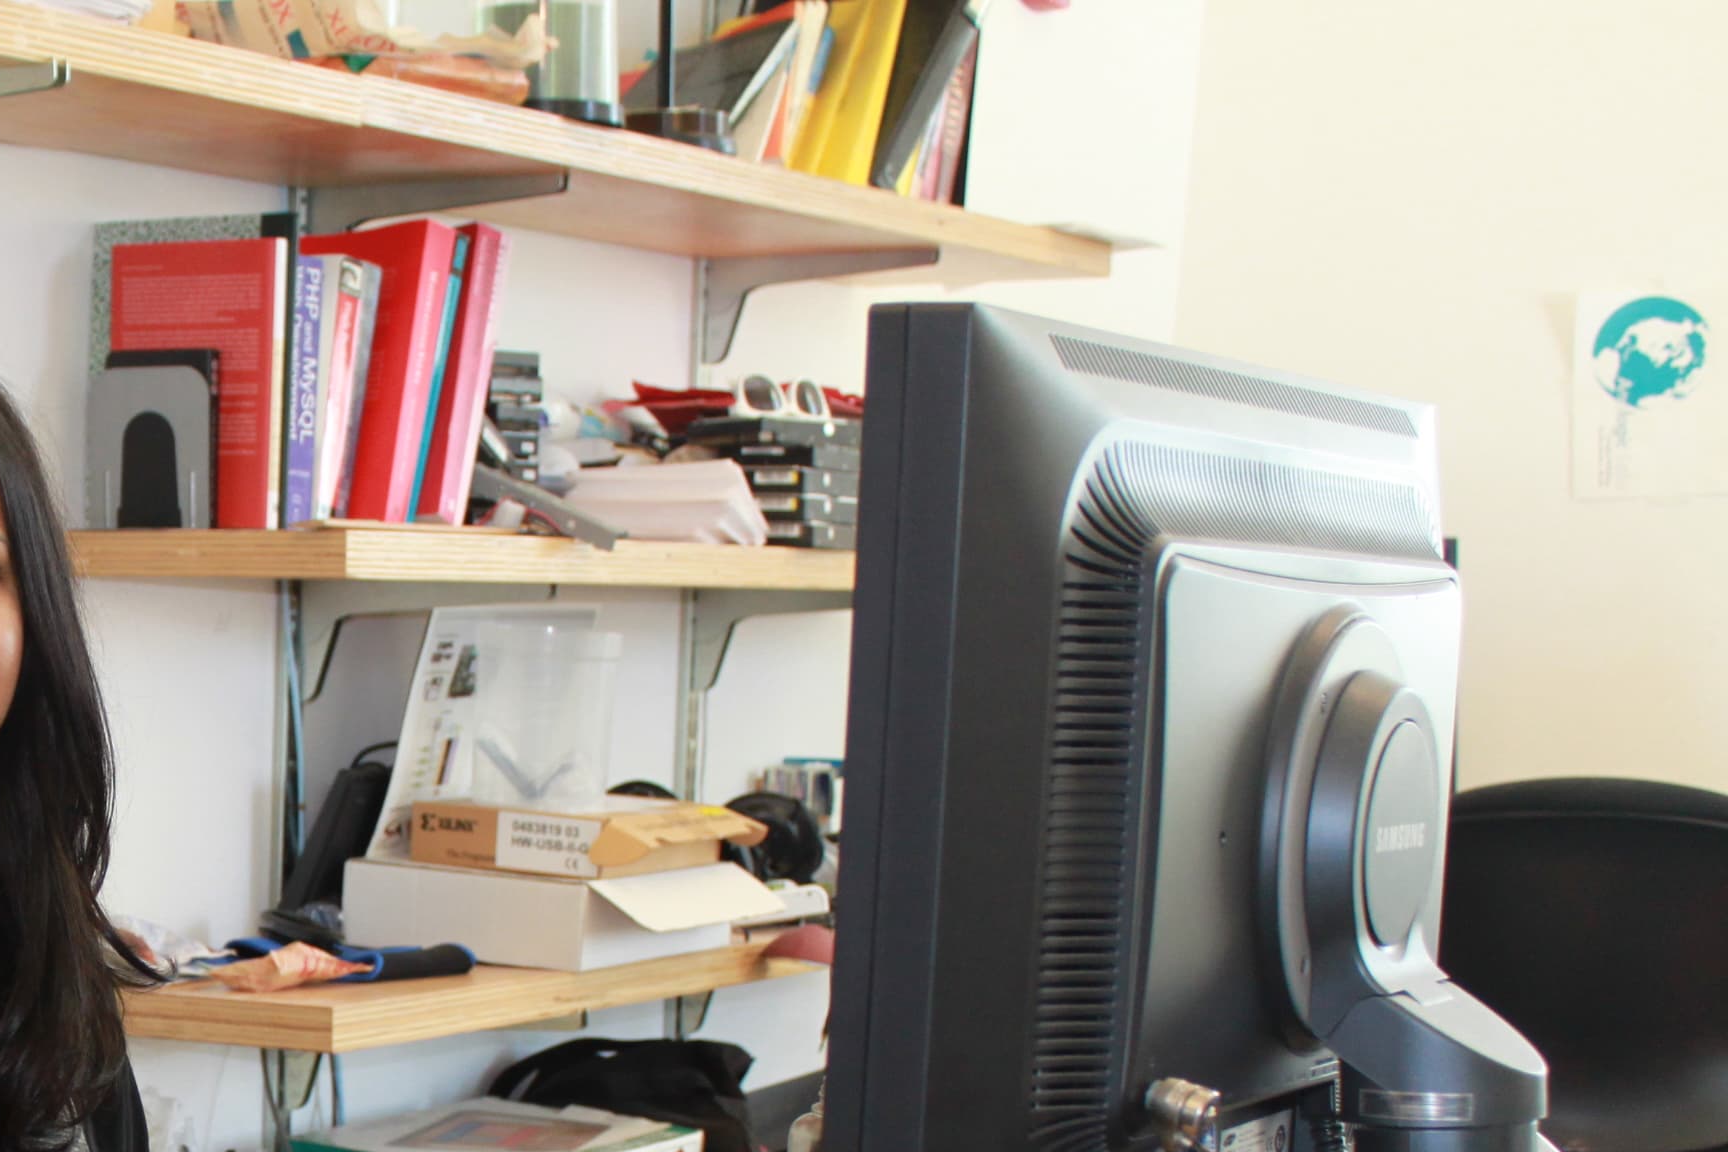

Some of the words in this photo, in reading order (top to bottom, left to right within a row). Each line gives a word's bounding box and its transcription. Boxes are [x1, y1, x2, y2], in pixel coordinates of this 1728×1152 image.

[304, 266, 321, 319] PHP
[298, 356, 319, 445] MySQL
[1375, 822, 1425, 854] SAMSUNG
